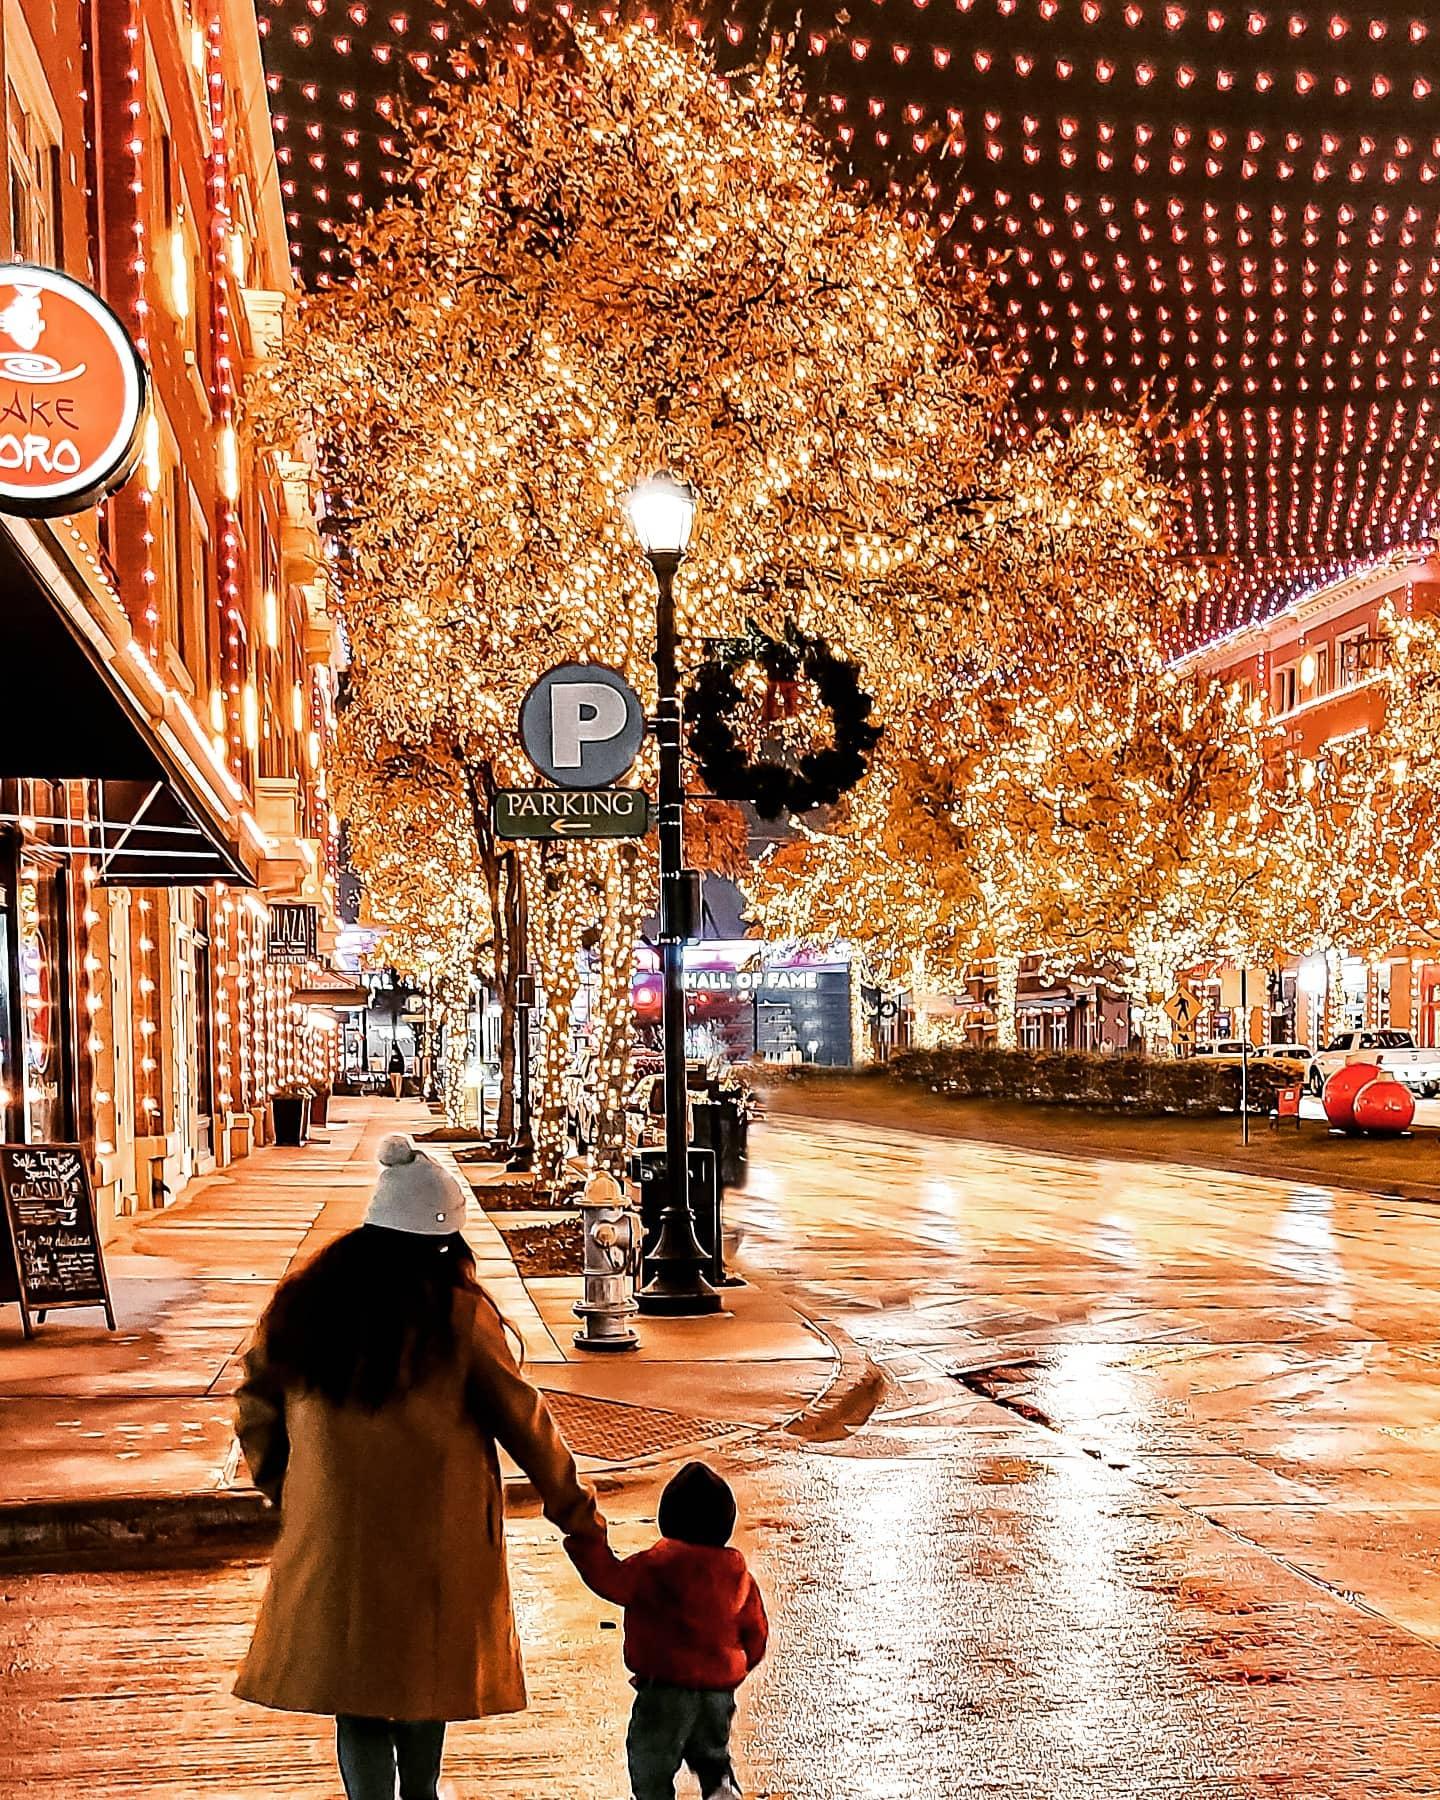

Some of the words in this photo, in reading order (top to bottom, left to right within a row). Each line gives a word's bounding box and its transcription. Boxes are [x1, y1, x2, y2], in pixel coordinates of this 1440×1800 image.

[0, 388, 80, 430] AKE
[0, 431, 81, 475] ORO
[550, 683, 628, 769] P
[507, 793, 634, 817] PARKING
[269, 905, 306, 942] PLAZA
[683, 972, 732, 989] HALL
[736, 972, 763, 989] OF
[767, 972, 817, 989] FAME
